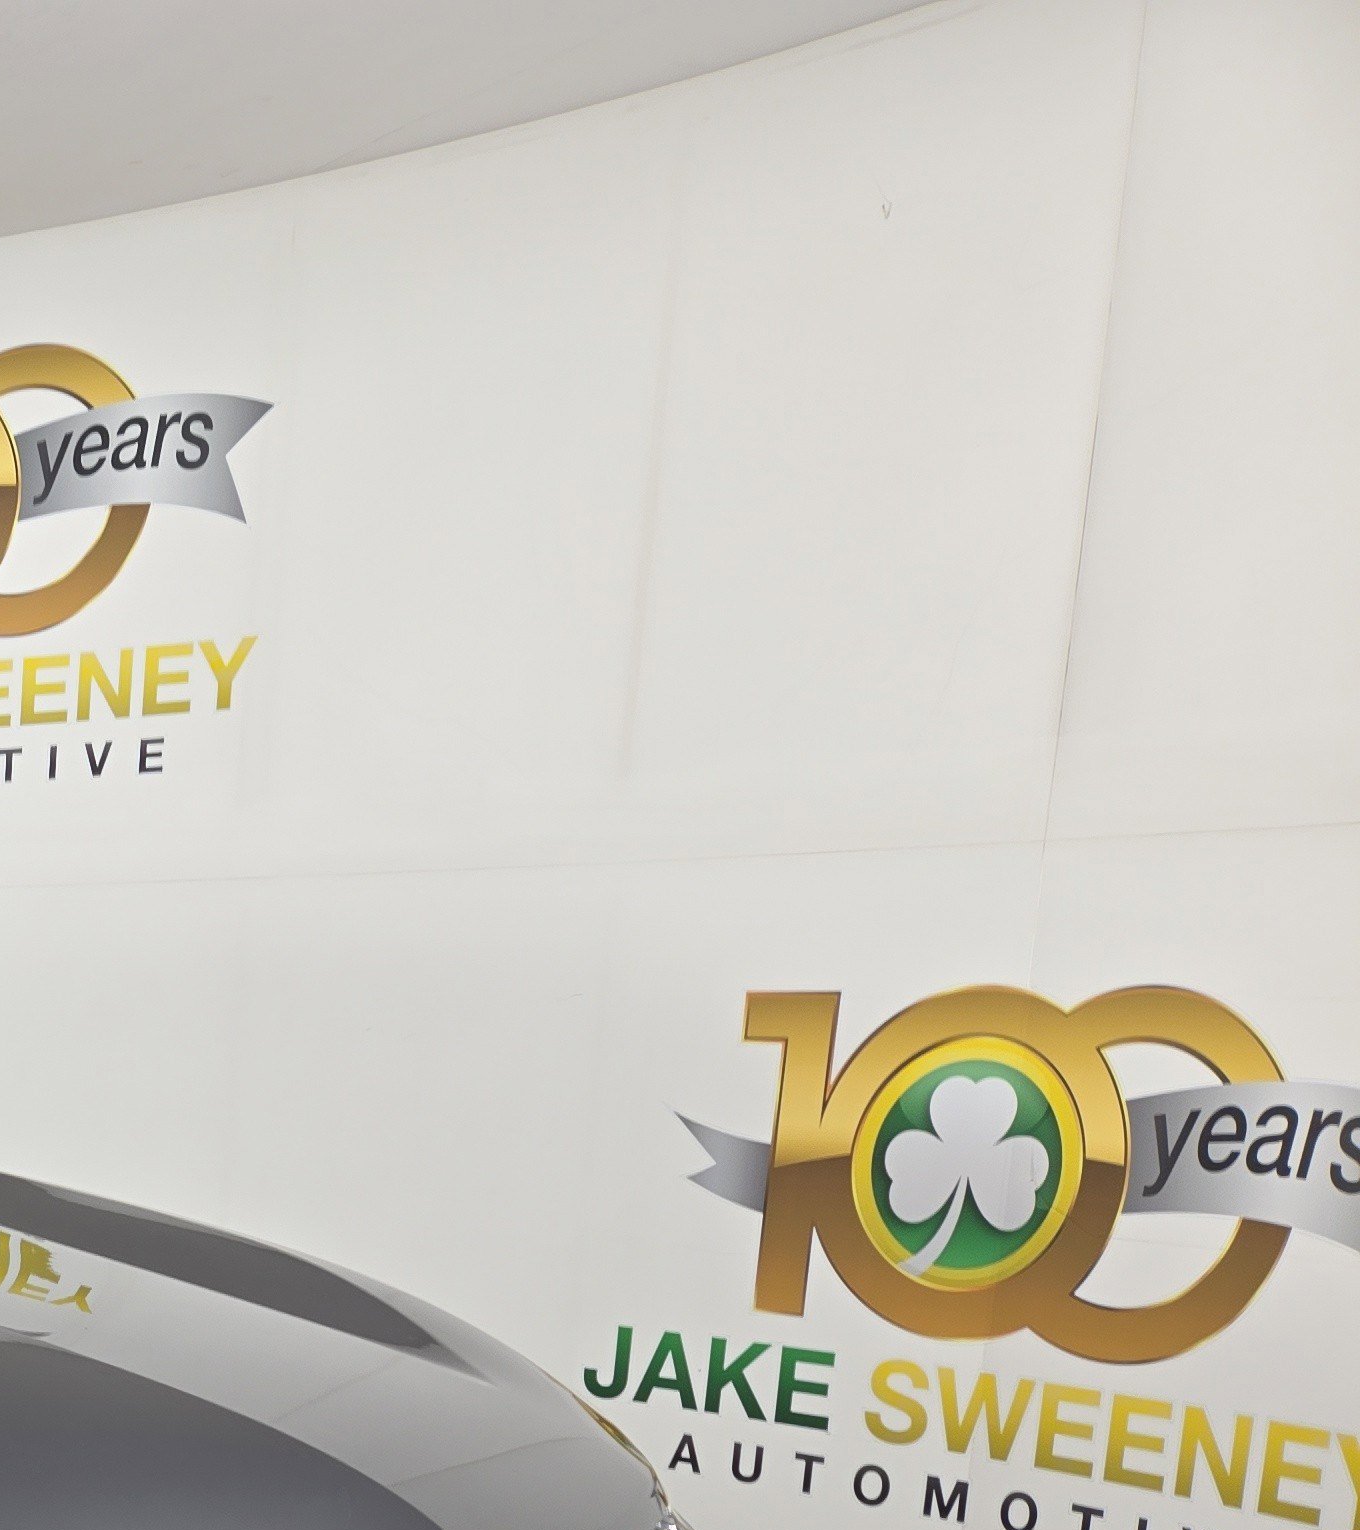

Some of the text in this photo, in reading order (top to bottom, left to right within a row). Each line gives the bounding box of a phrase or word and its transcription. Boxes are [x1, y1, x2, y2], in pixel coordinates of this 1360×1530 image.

[34, 410, 213, 505] years
[743, 984, 1292, 1364] 100
[583, 1325, 835, 1432] JAKE
